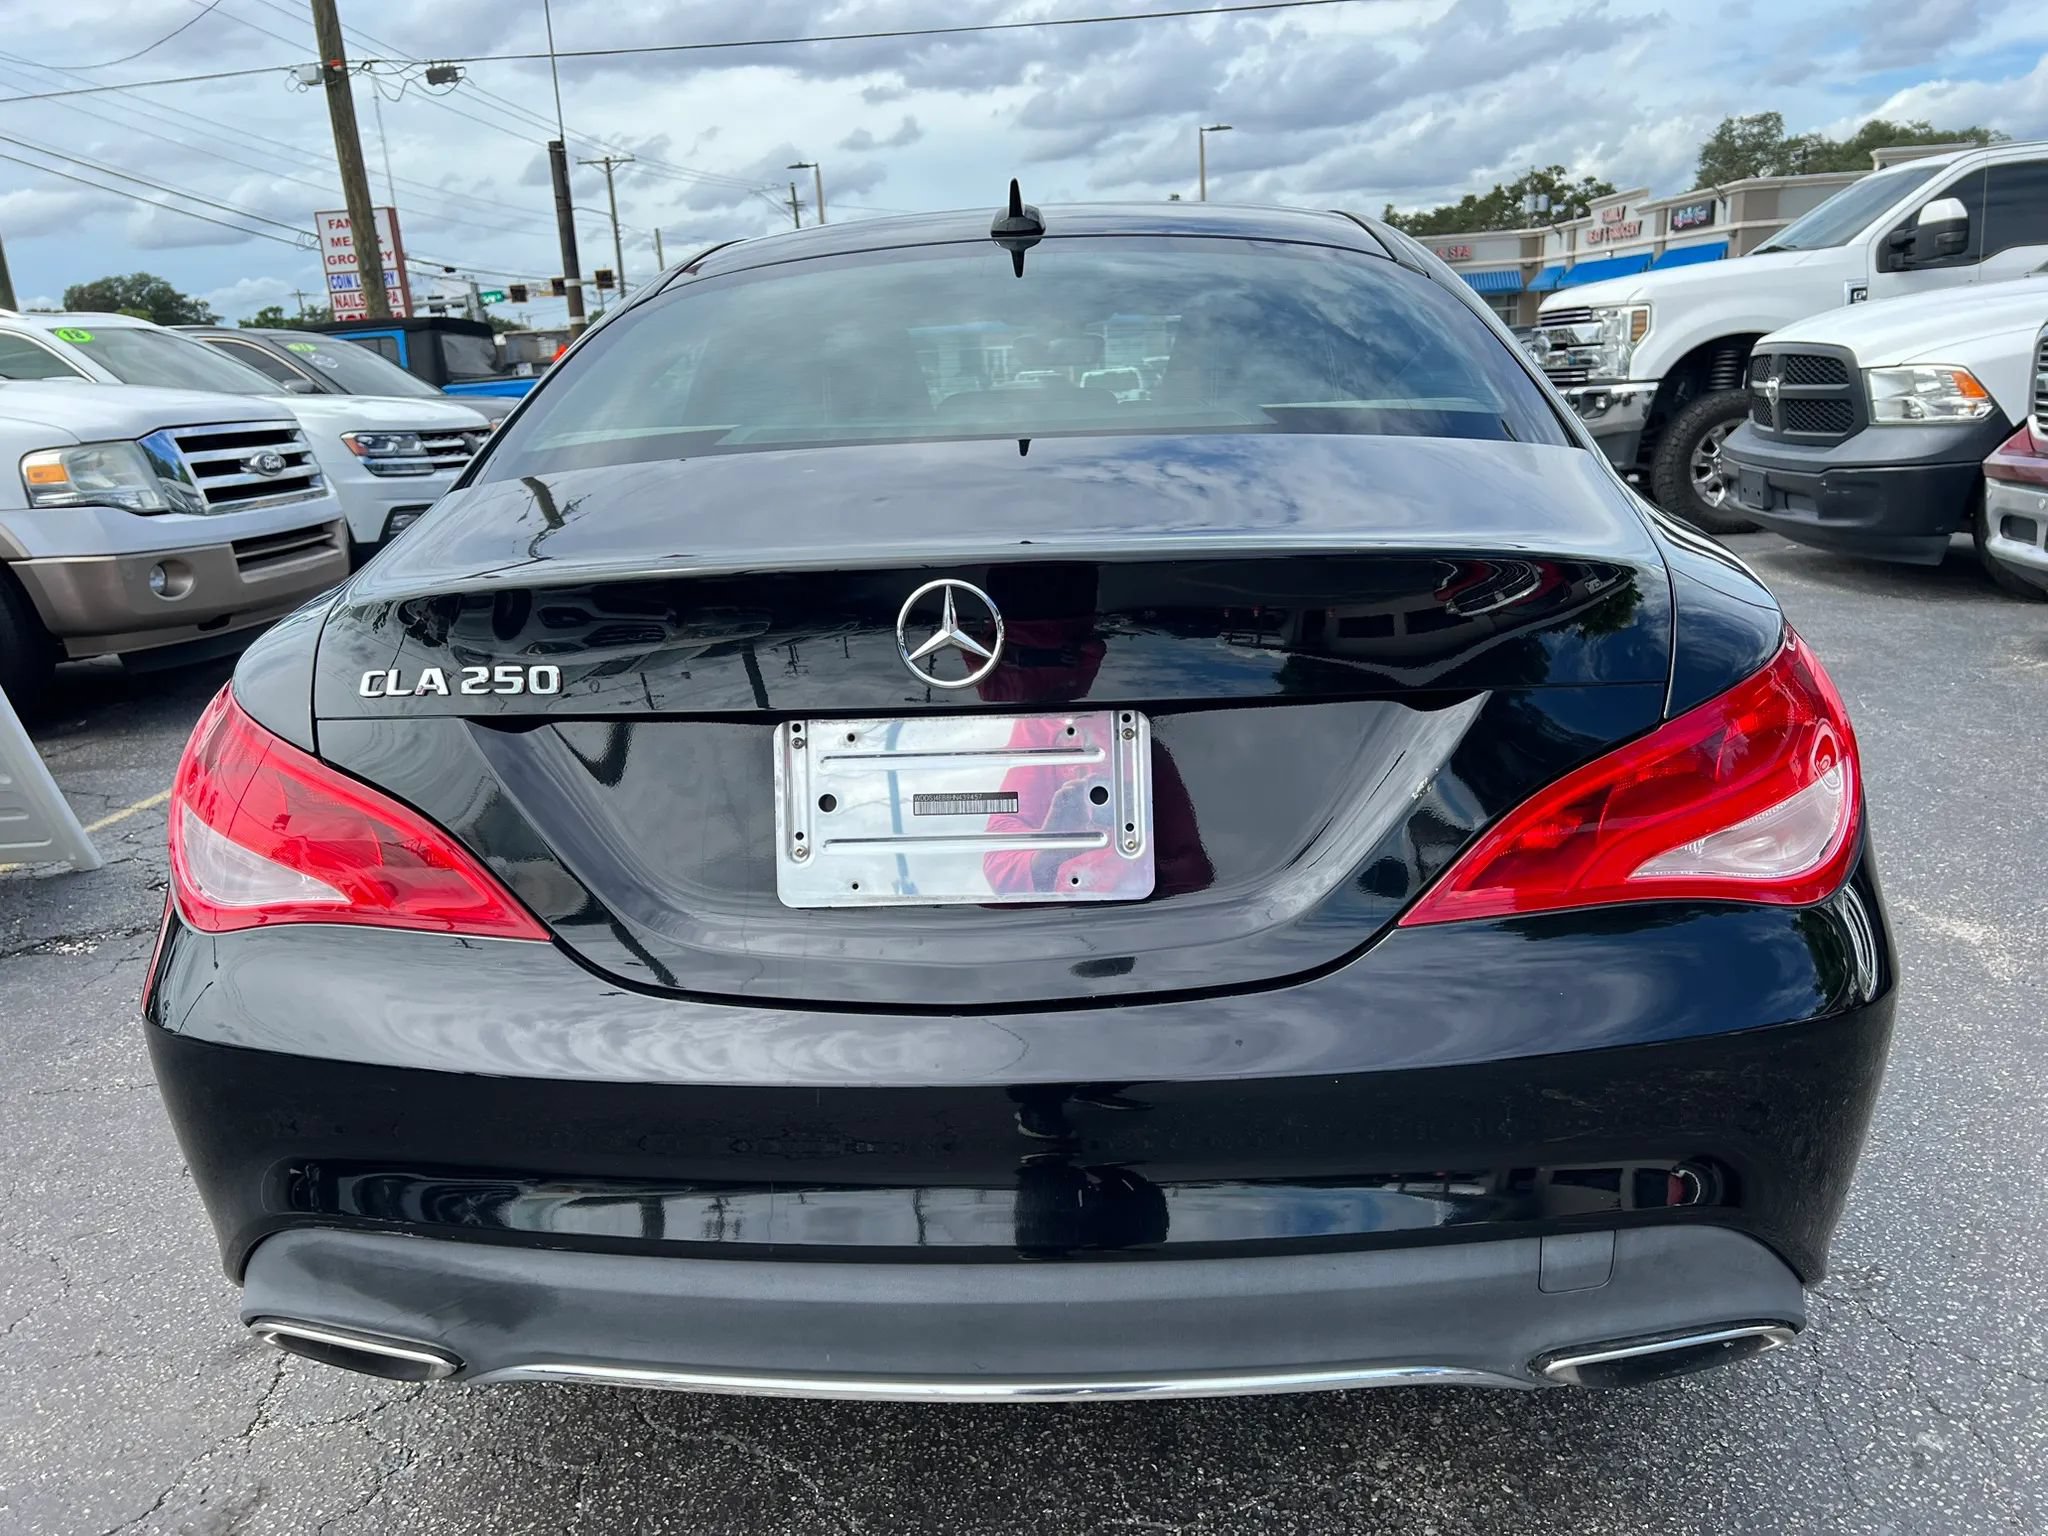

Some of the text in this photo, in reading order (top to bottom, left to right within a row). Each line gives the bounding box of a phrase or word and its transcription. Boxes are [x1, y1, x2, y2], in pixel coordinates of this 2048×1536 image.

[1449, 245, 1471, 258] SPA
[330, 274, 353, 289] COIN
[359, 665, 560, 697] CLA 250
